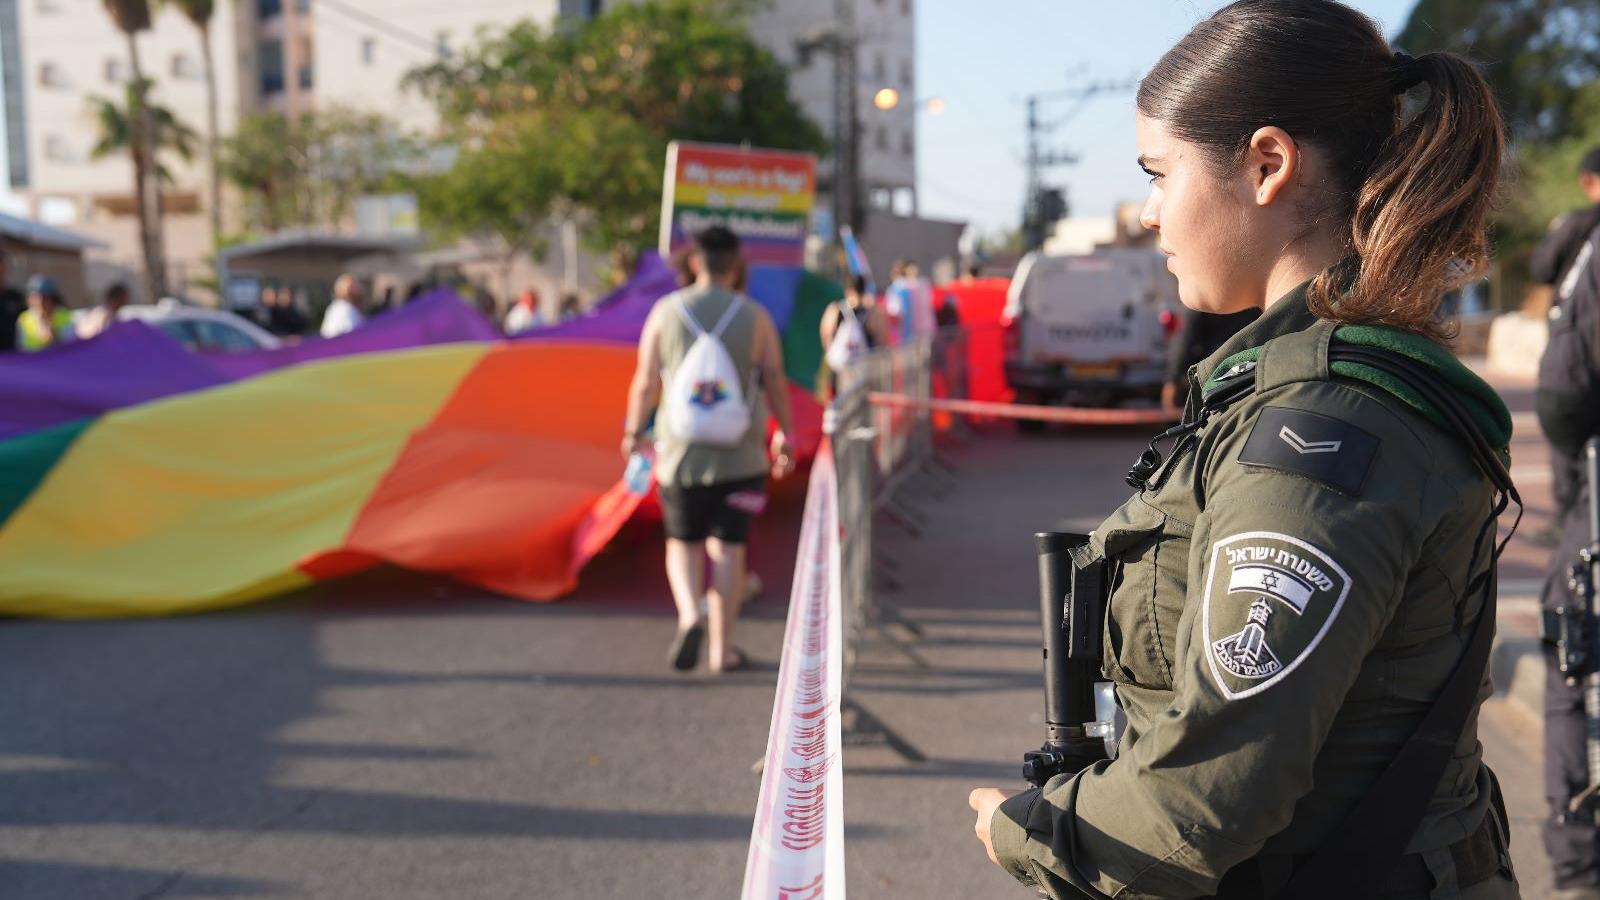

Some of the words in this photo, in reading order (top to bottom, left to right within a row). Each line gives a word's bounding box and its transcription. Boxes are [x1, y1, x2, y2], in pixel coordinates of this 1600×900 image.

[1226, 546, 1275, 565] ישראל
[1274, 549, 1335, 592] משטרת
[1215, 638, 1240, 673] הגבול
[1241, 660, 1279, 675] משמר
[781, 783, 824, 851] משטרת
